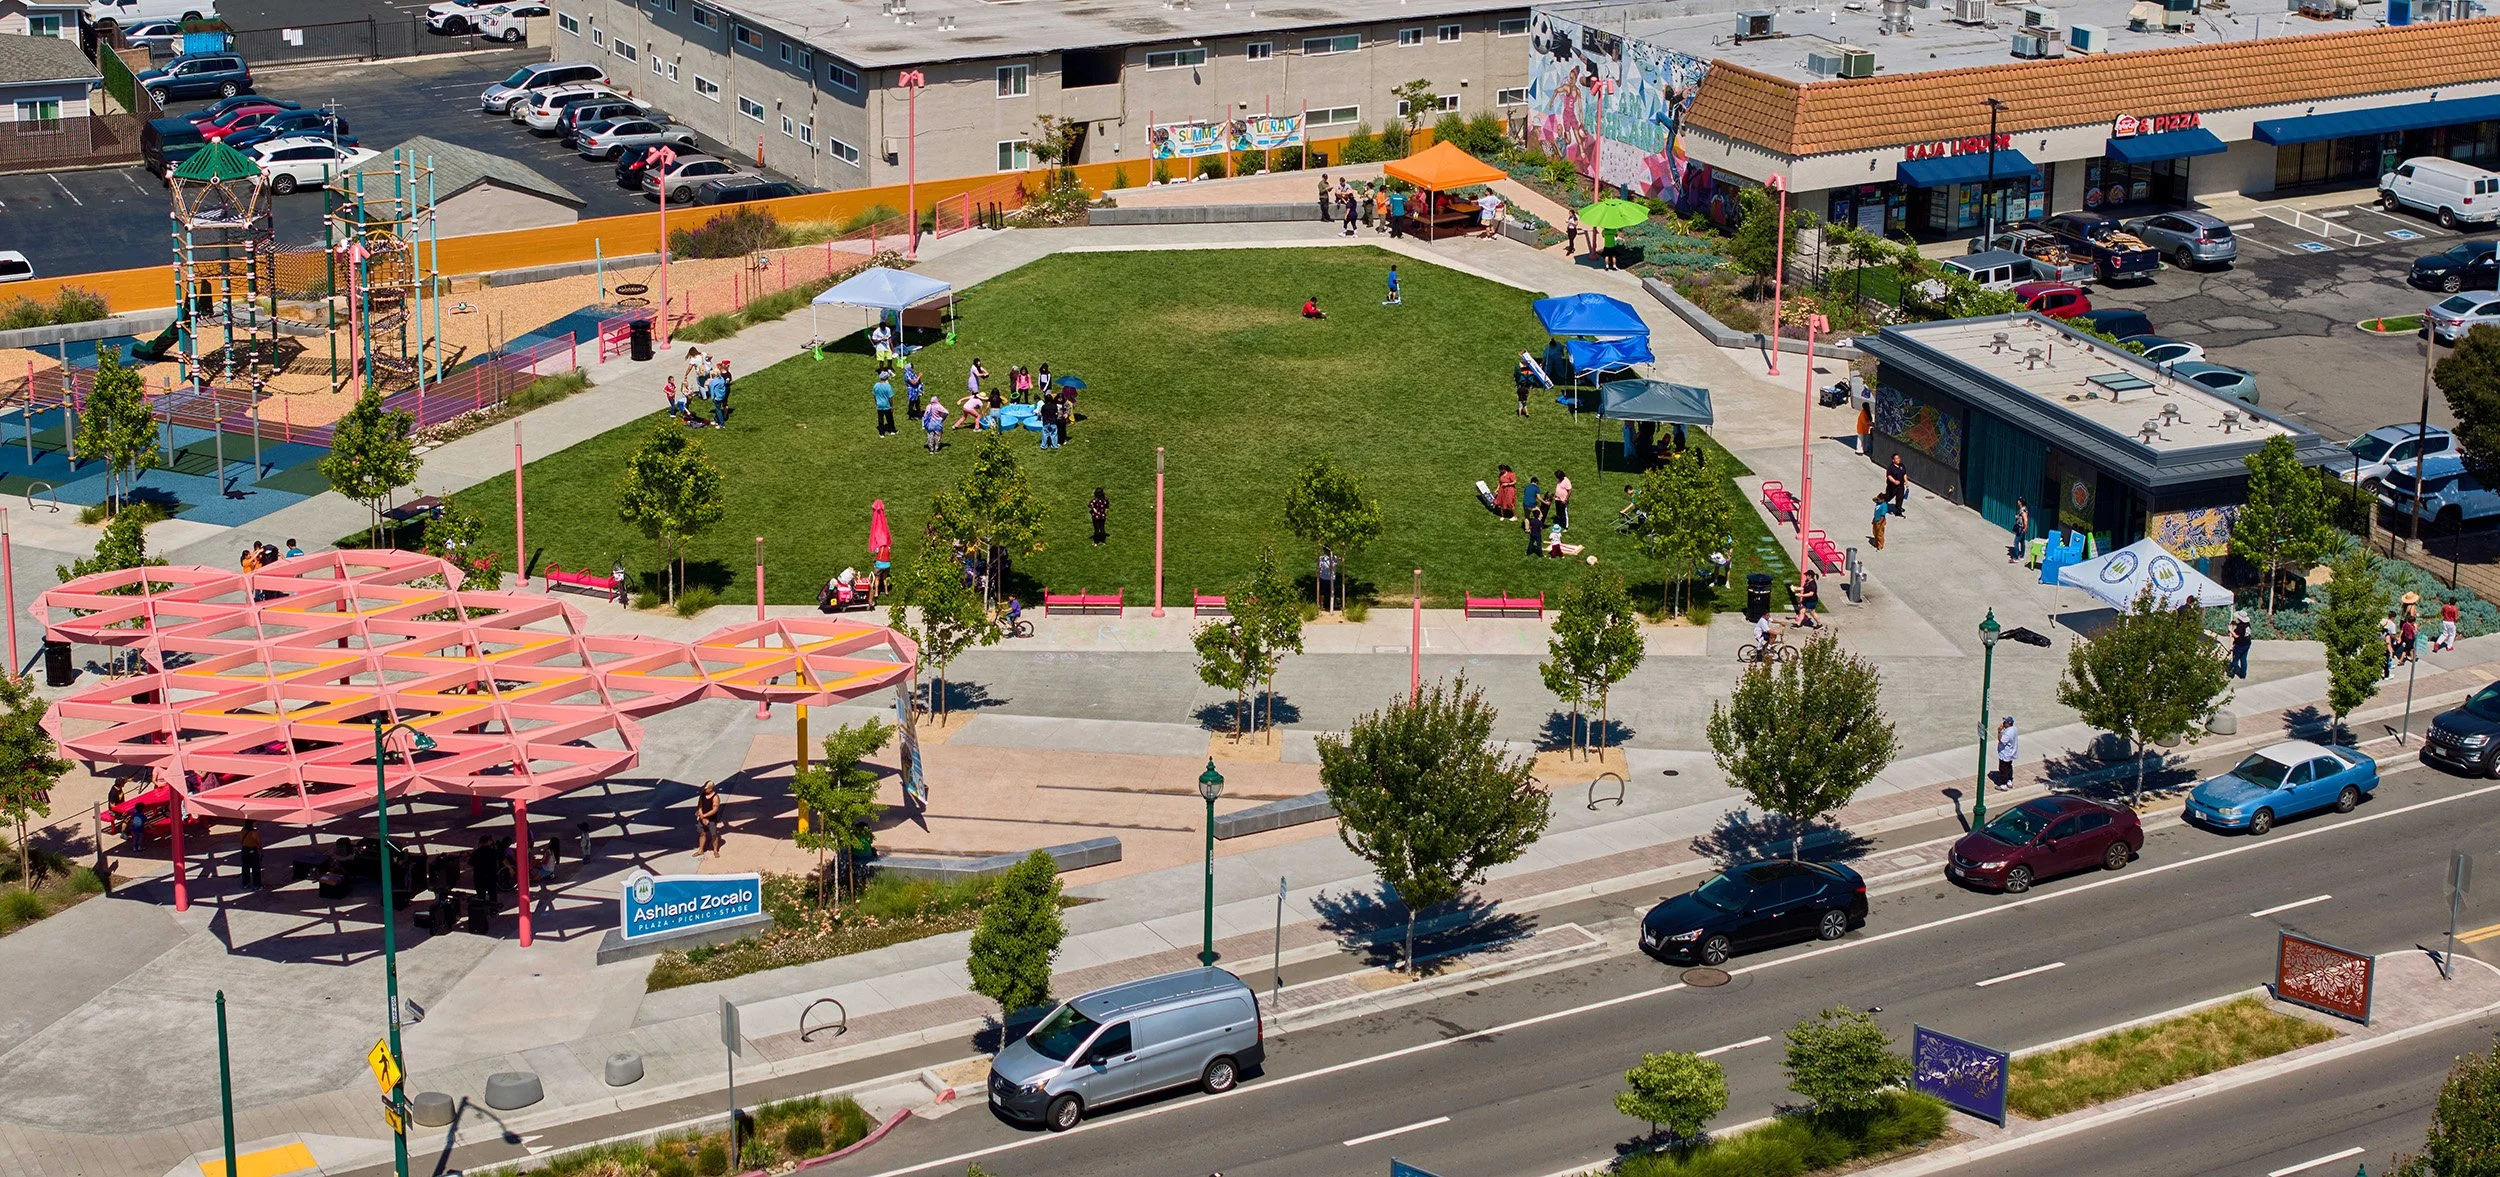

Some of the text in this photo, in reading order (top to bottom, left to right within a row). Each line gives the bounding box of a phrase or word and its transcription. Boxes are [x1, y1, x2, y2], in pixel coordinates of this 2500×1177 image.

[1256, 118, 1300, 133] VERANO
[2139, 118, 2149, 132] &
[2156, 113, 2201, 130] PIZZA
[1906, 143, 1945, 159] RAJA
[634, 889, 753, 922] Ashland Zocalo
[638, 905, 748, 931] PLAZA PICNIC STAGE
